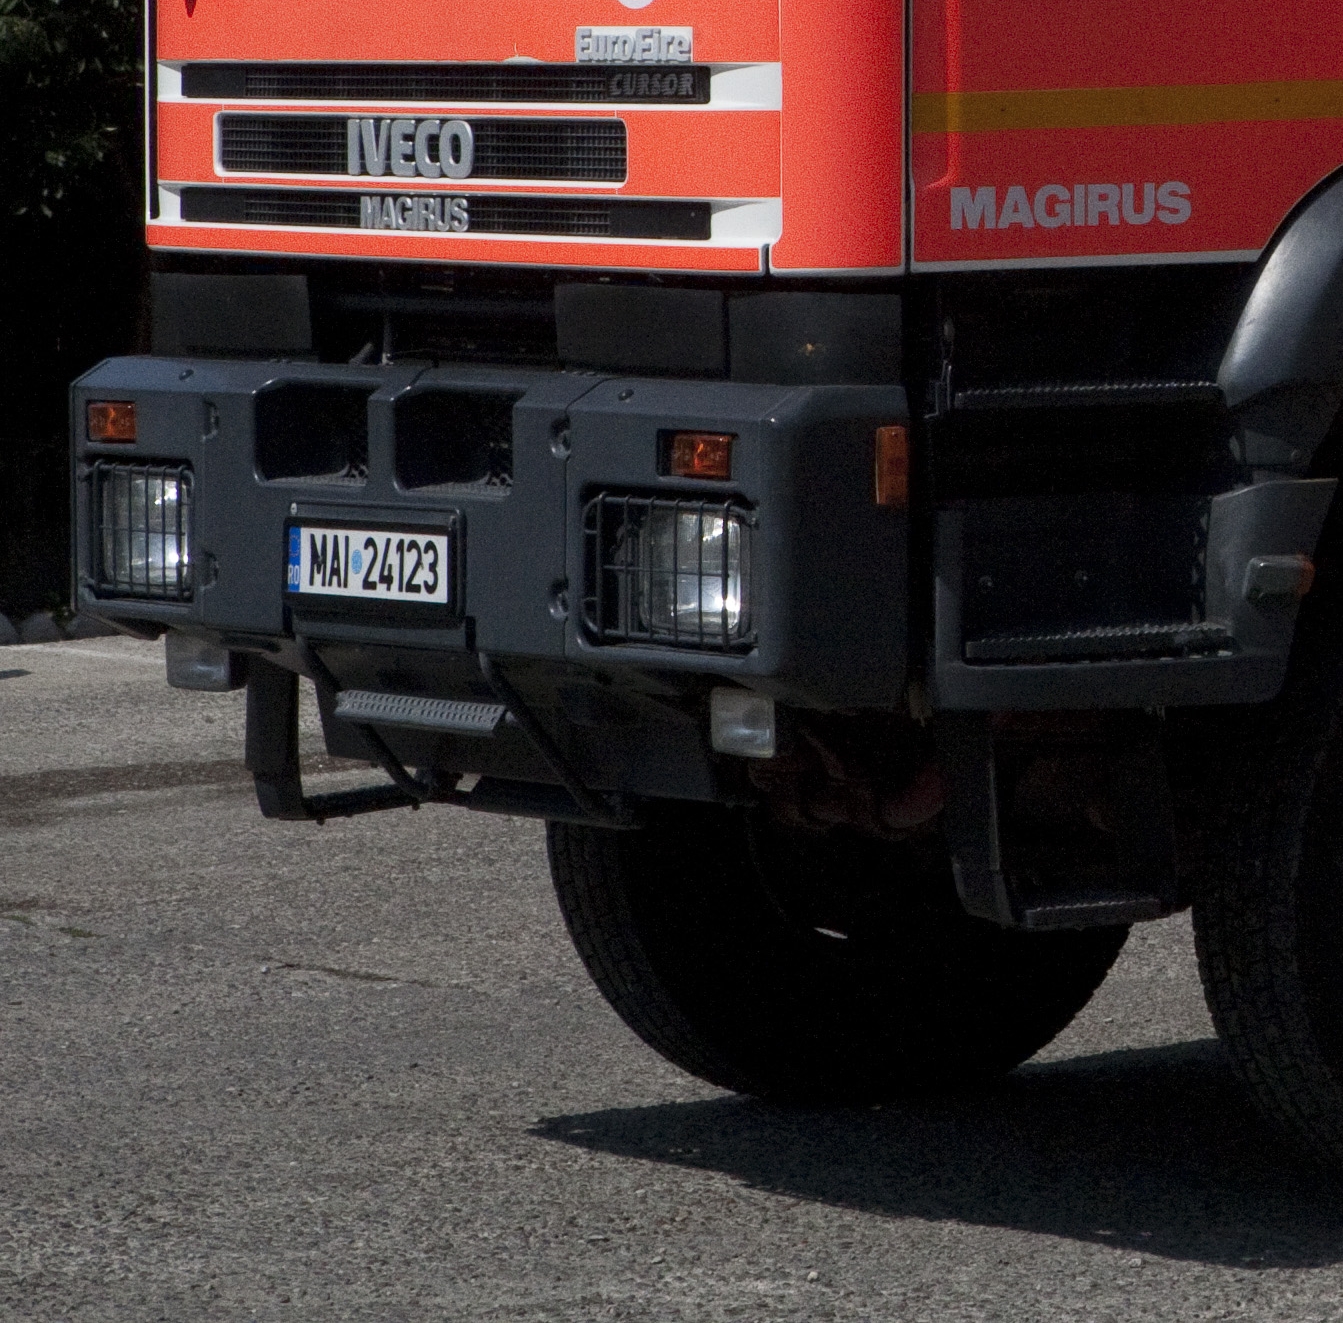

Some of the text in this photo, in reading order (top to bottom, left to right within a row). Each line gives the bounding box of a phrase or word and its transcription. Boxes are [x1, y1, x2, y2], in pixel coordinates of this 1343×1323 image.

[575, 27, 692, 63] EuroFire
[609, 71, 694, 96] CURSOR
[346, 118, 475, 180] IVECO
[359, 195, 470, 233] MAGIRUS
[950, 181, 1192, 230] MAGIRUS
[287, 564, 300, 585] RO
[309, 533, 439, 595] MAI 24123
